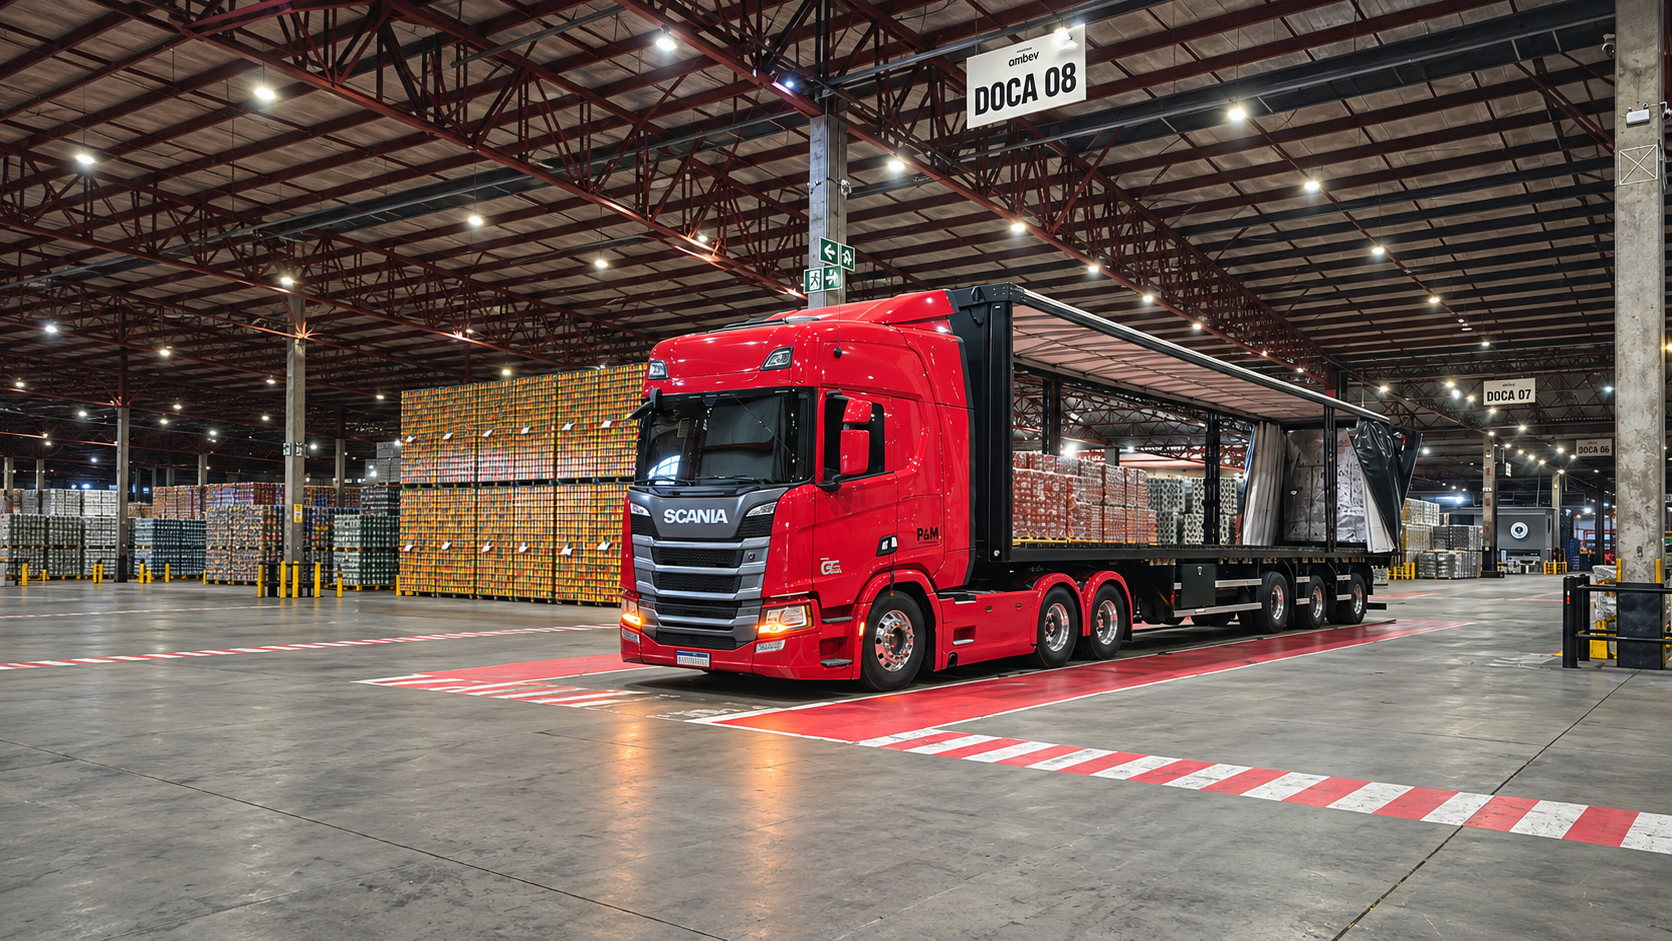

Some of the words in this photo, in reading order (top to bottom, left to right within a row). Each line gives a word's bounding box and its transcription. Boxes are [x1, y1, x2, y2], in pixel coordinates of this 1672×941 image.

[1008, 51, 1040, 67] ambev
[975, 73, 1038, 116] DOCA
[1045, 62, 1077, 97] 08
[1487, 390, 1515, 402] DOCA
[1518, 389, 1531, 400] 07
[663, 509, 728, 524] SCANIA
